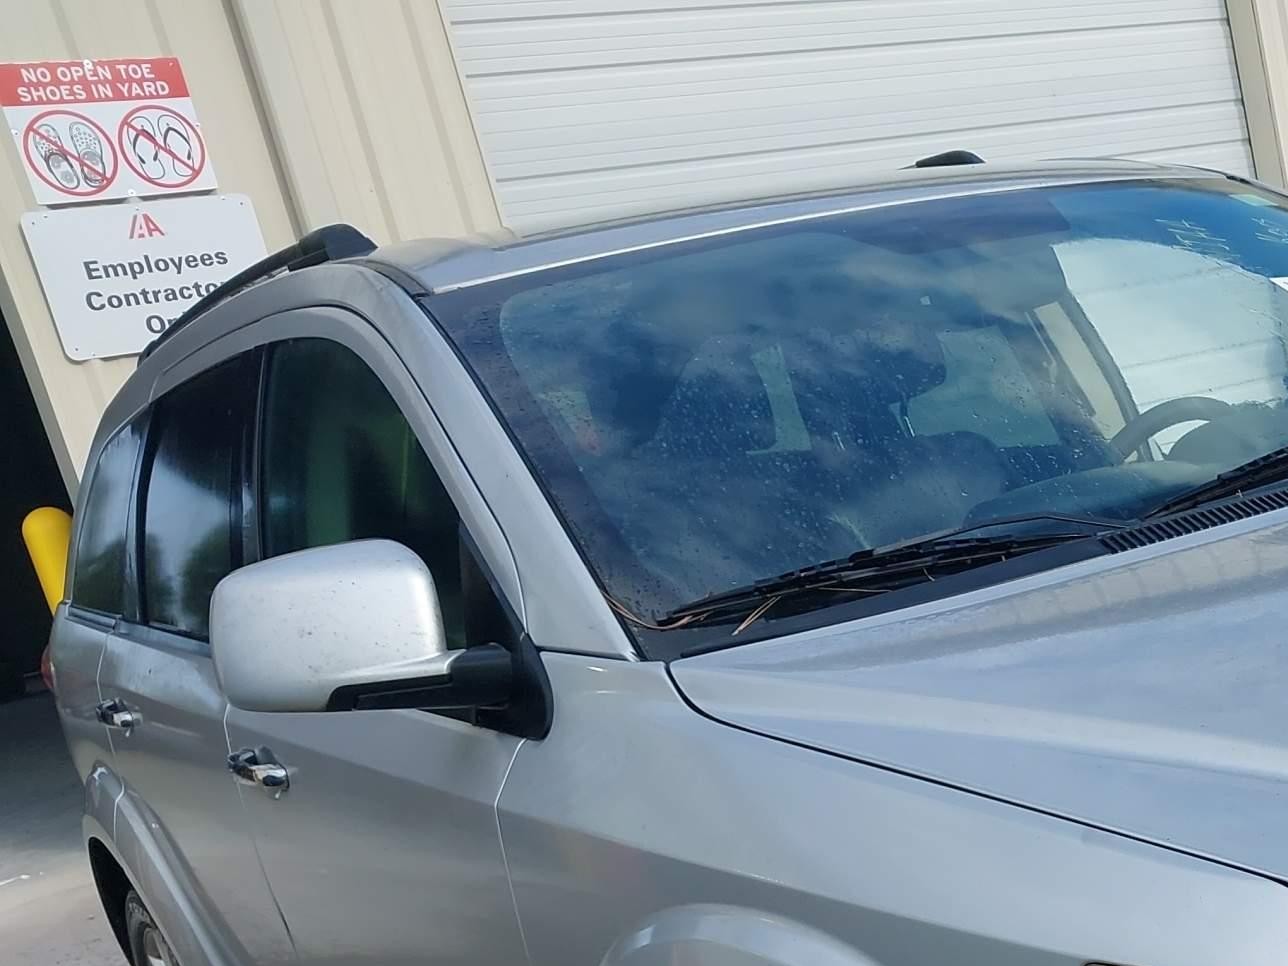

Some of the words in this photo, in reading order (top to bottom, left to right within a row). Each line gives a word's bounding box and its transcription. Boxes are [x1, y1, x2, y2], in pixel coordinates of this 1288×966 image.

[20, 67, 51, 83] NO
[57, 66, 112, 82] OPEN
[116, 63, 155, 79] TOE
[17, 84, 87, 102] SHOES
[91, 83, 113, 99] IN
[117, 80, 169, 97] YARD
[83, 250, 228, 281] Employees
[86, 281, 224, 311] Contracto
